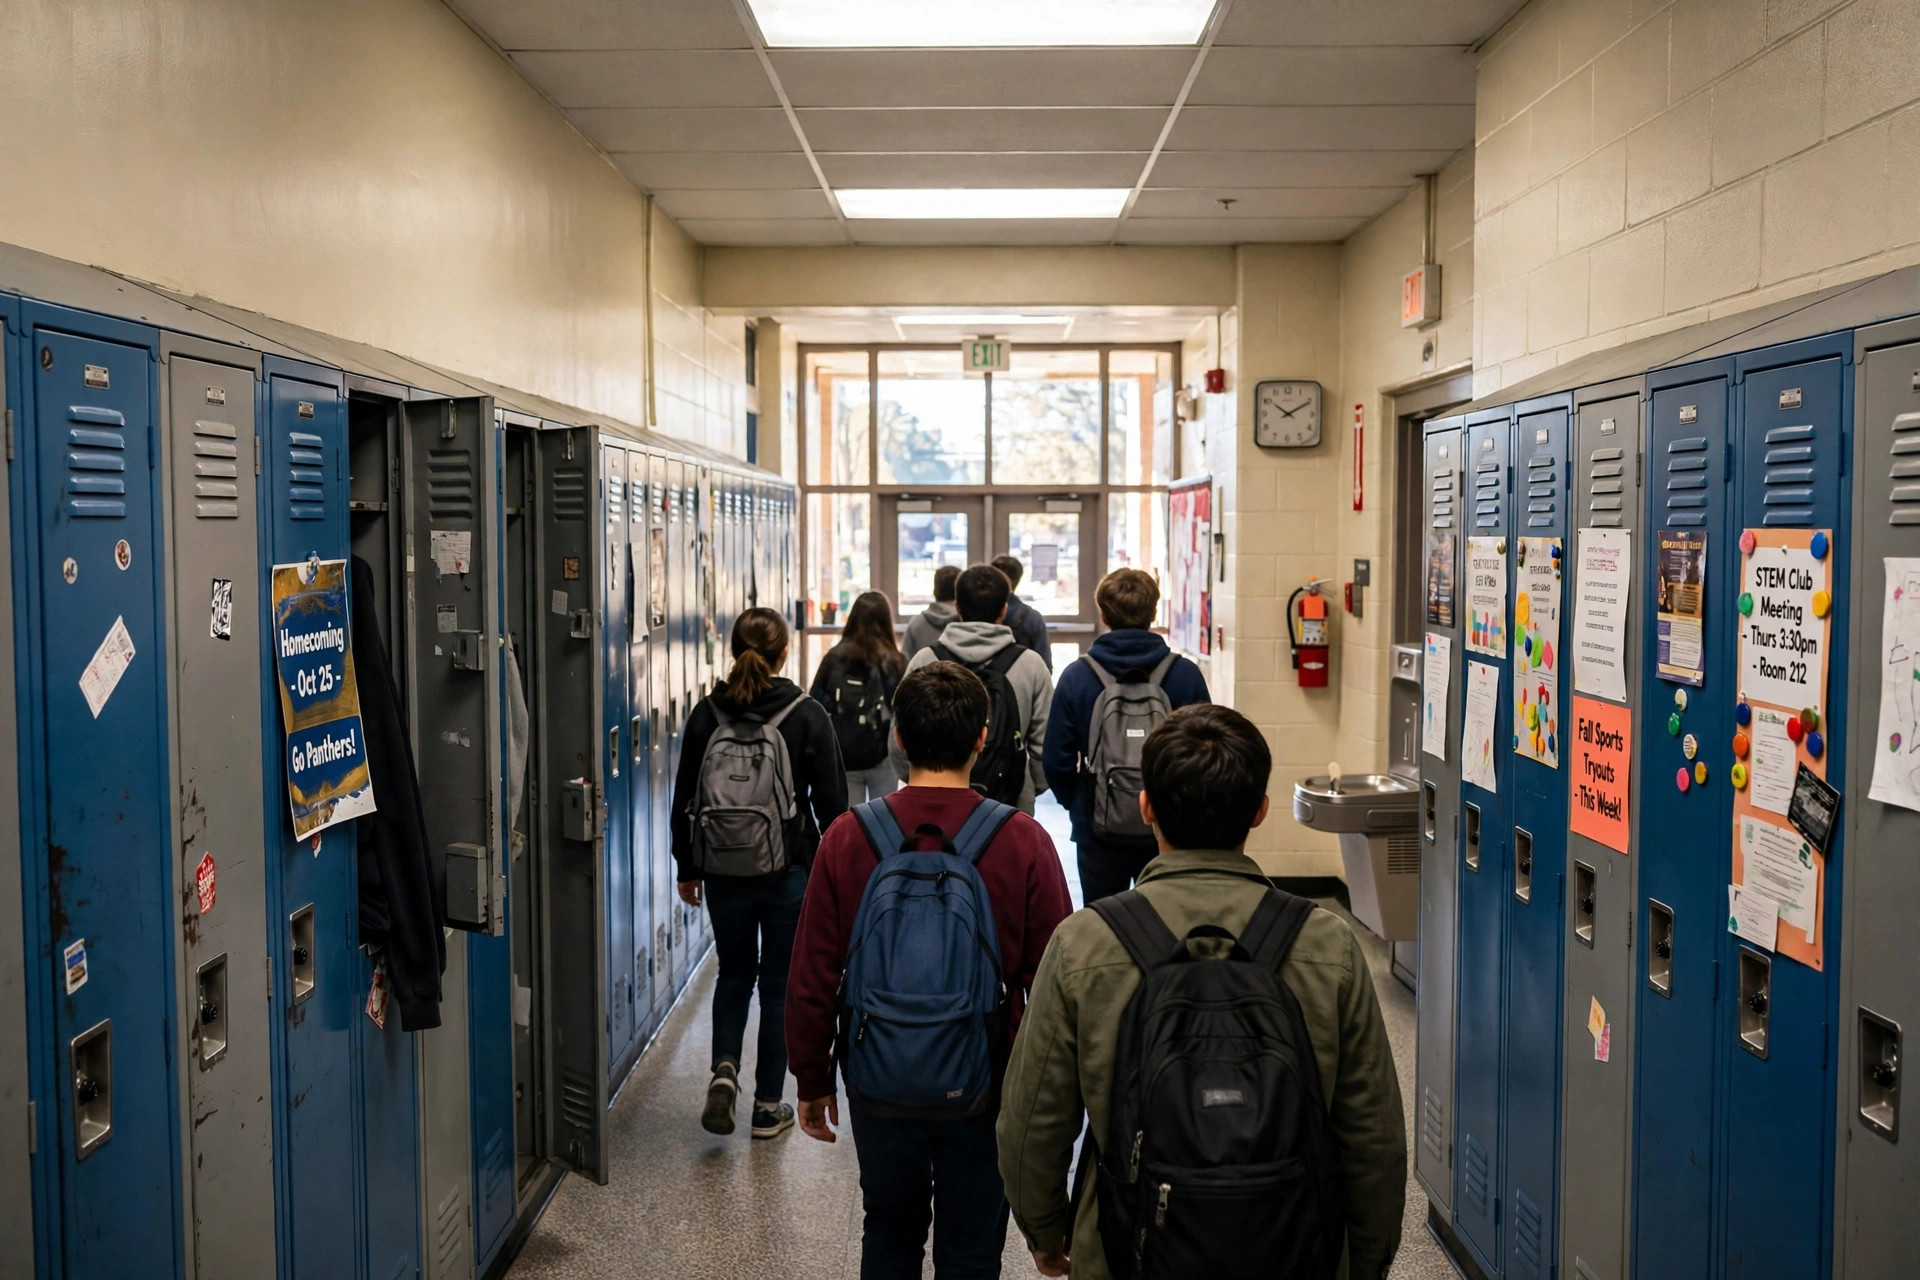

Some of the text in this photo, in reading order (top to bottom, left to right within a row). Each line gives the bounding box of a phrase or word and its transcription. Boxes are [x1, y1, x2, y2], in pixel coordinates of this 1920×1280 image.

[972, 342, 1001, 367] EXIT
[1755, 566, 1813, 590] STEM Club
[1760, 596, 1803, 626] Meeting
[280, 621, 344, 657] Homecoming
[1751, 625, 1777, 648] Thurs
[1779, 628, 1817, 658] 3:30pm
[297, 668, 317, 698] Oct
[318, 664, 333, 693] 25
[1760, 656, 1787, 680] Room
[1789, 661, 1807, 684] 212
[292, 729, 356, 774] Go Panthers!
[1578, 718, 1623, 752] Fall Sports
[1584, 752, 1615, 784] Tryouts
[1579, 784, 1595, 812] This
[1597, 788, 1622, 822] Week!
